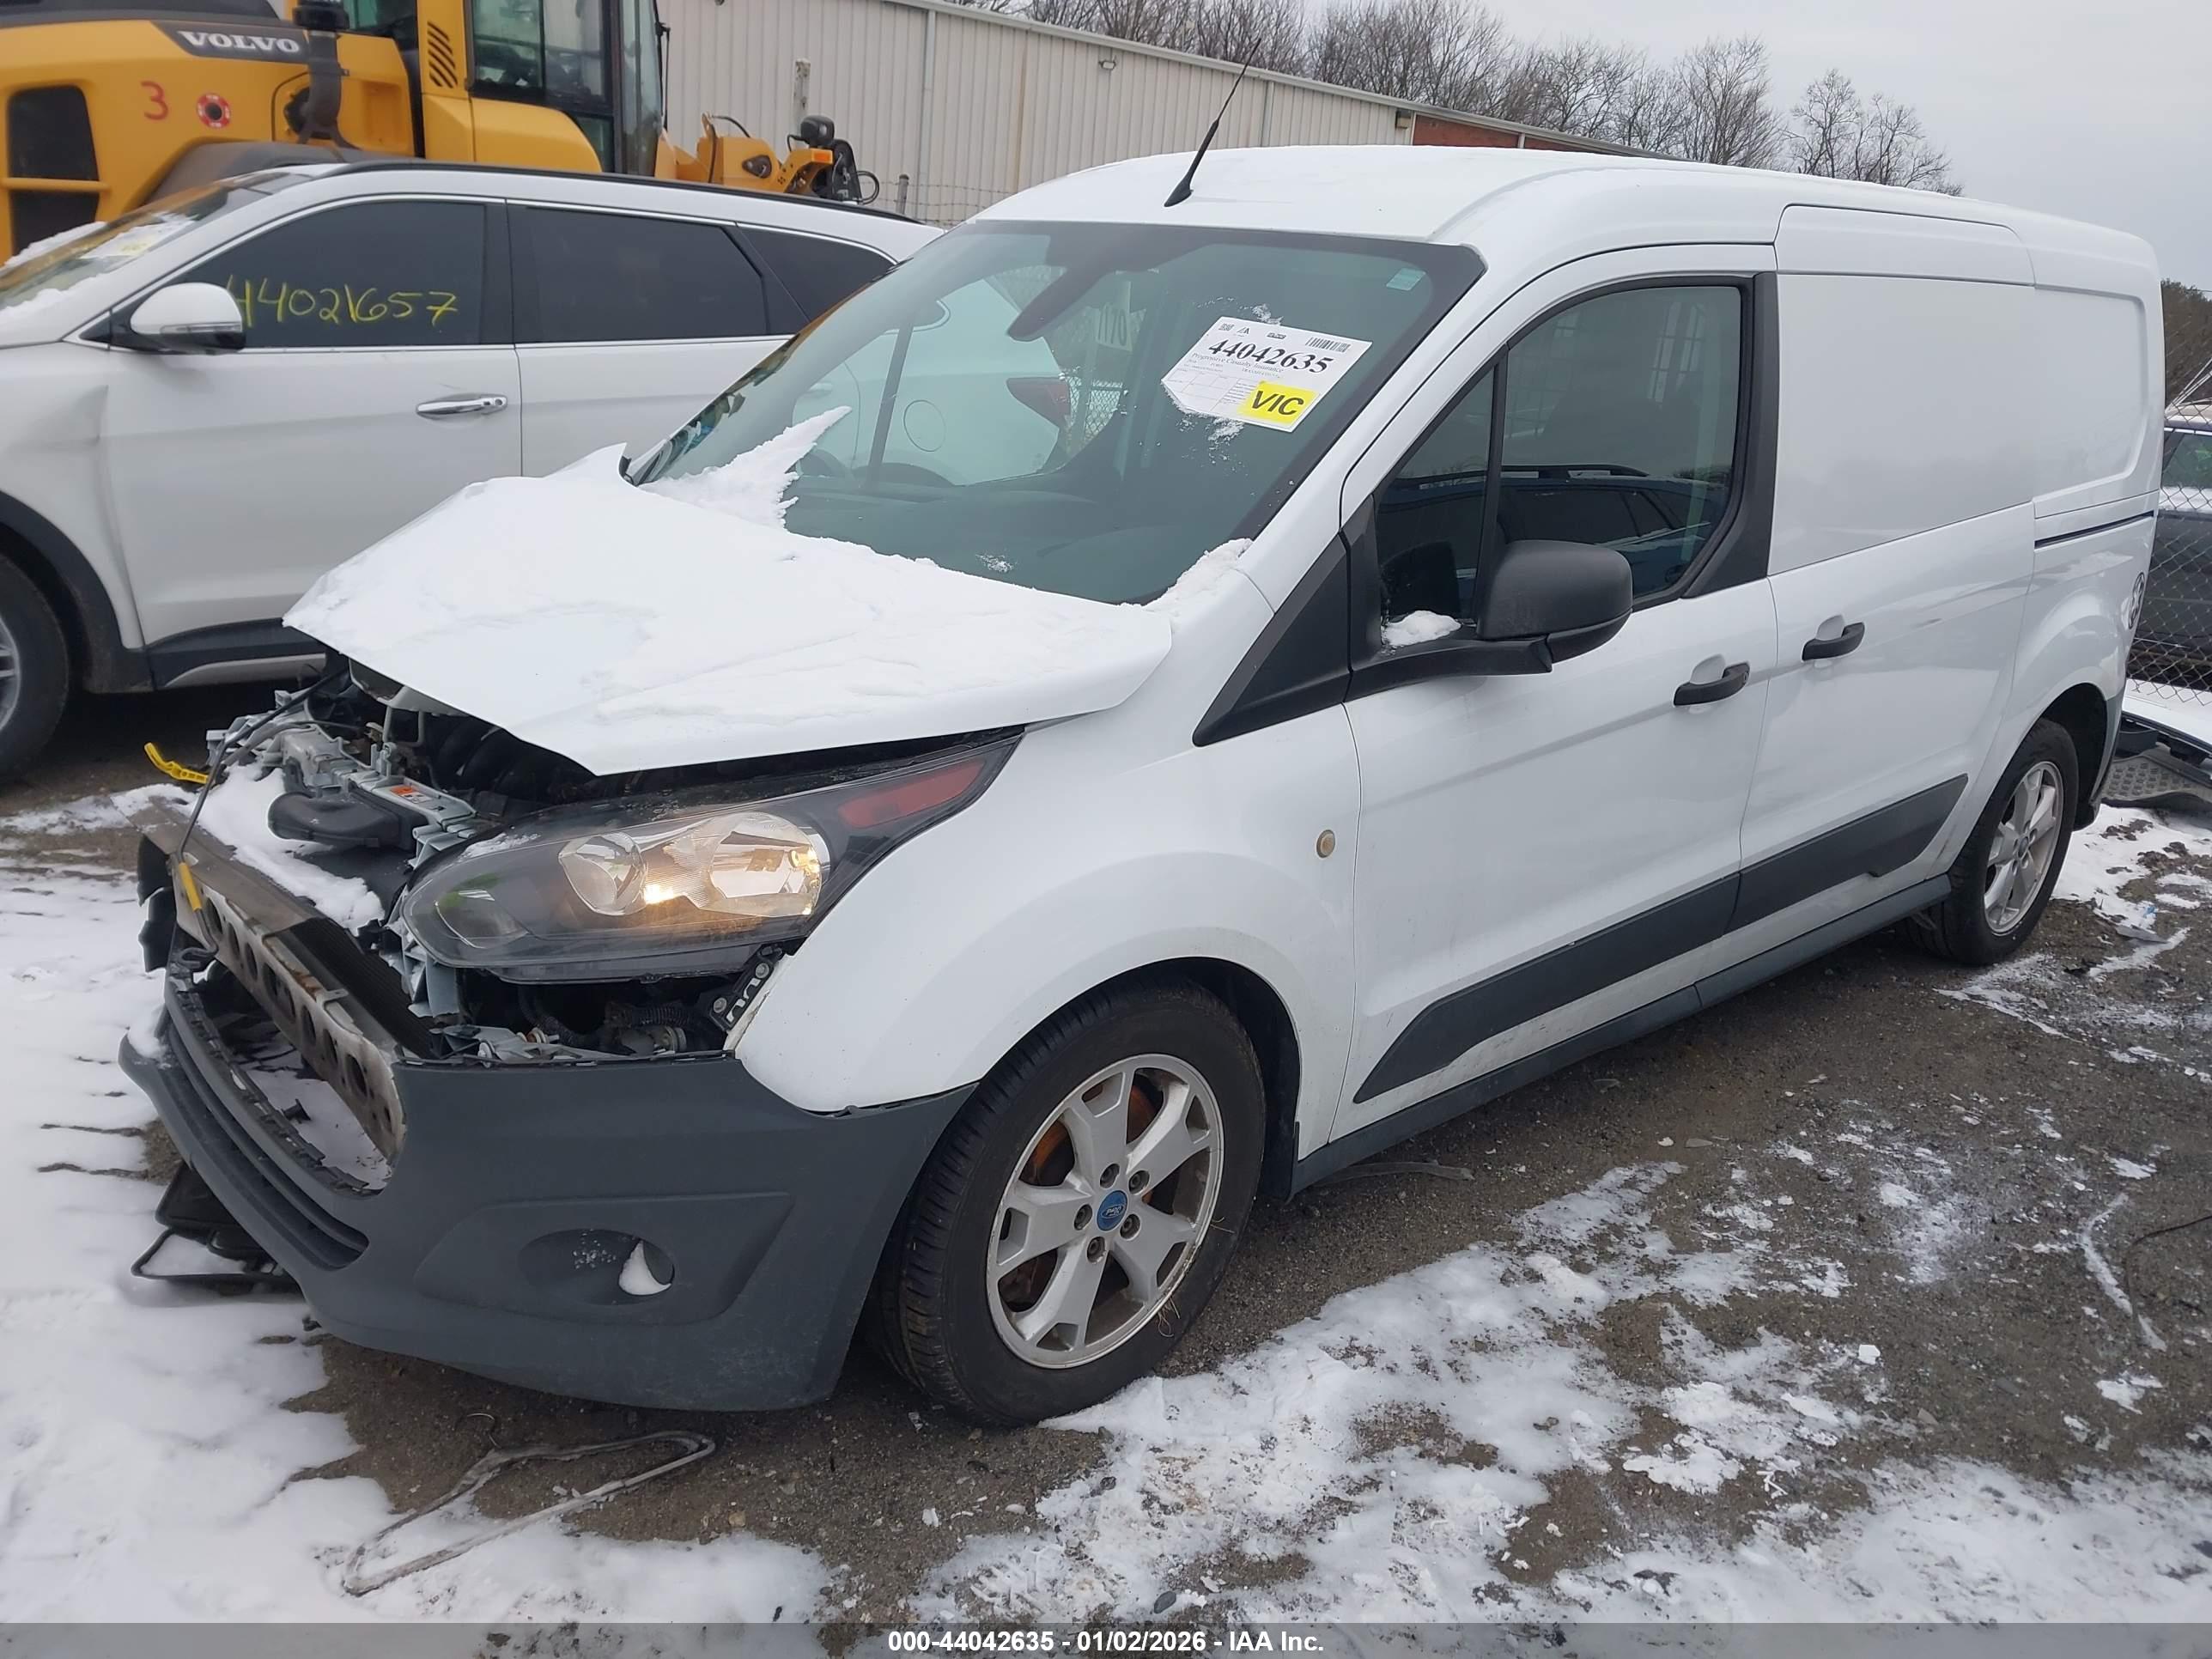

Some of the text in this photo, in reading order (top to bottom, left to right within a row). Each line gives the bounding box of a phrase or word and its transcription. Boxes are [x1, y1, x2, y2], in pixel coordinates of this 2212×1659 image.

[177, 30, 300, 53] VOLVO
[141, 81, 168, 120] 3
[1208, 339, 1334, 374] 44042635
[1251, 390, 1304, 416] VIC
